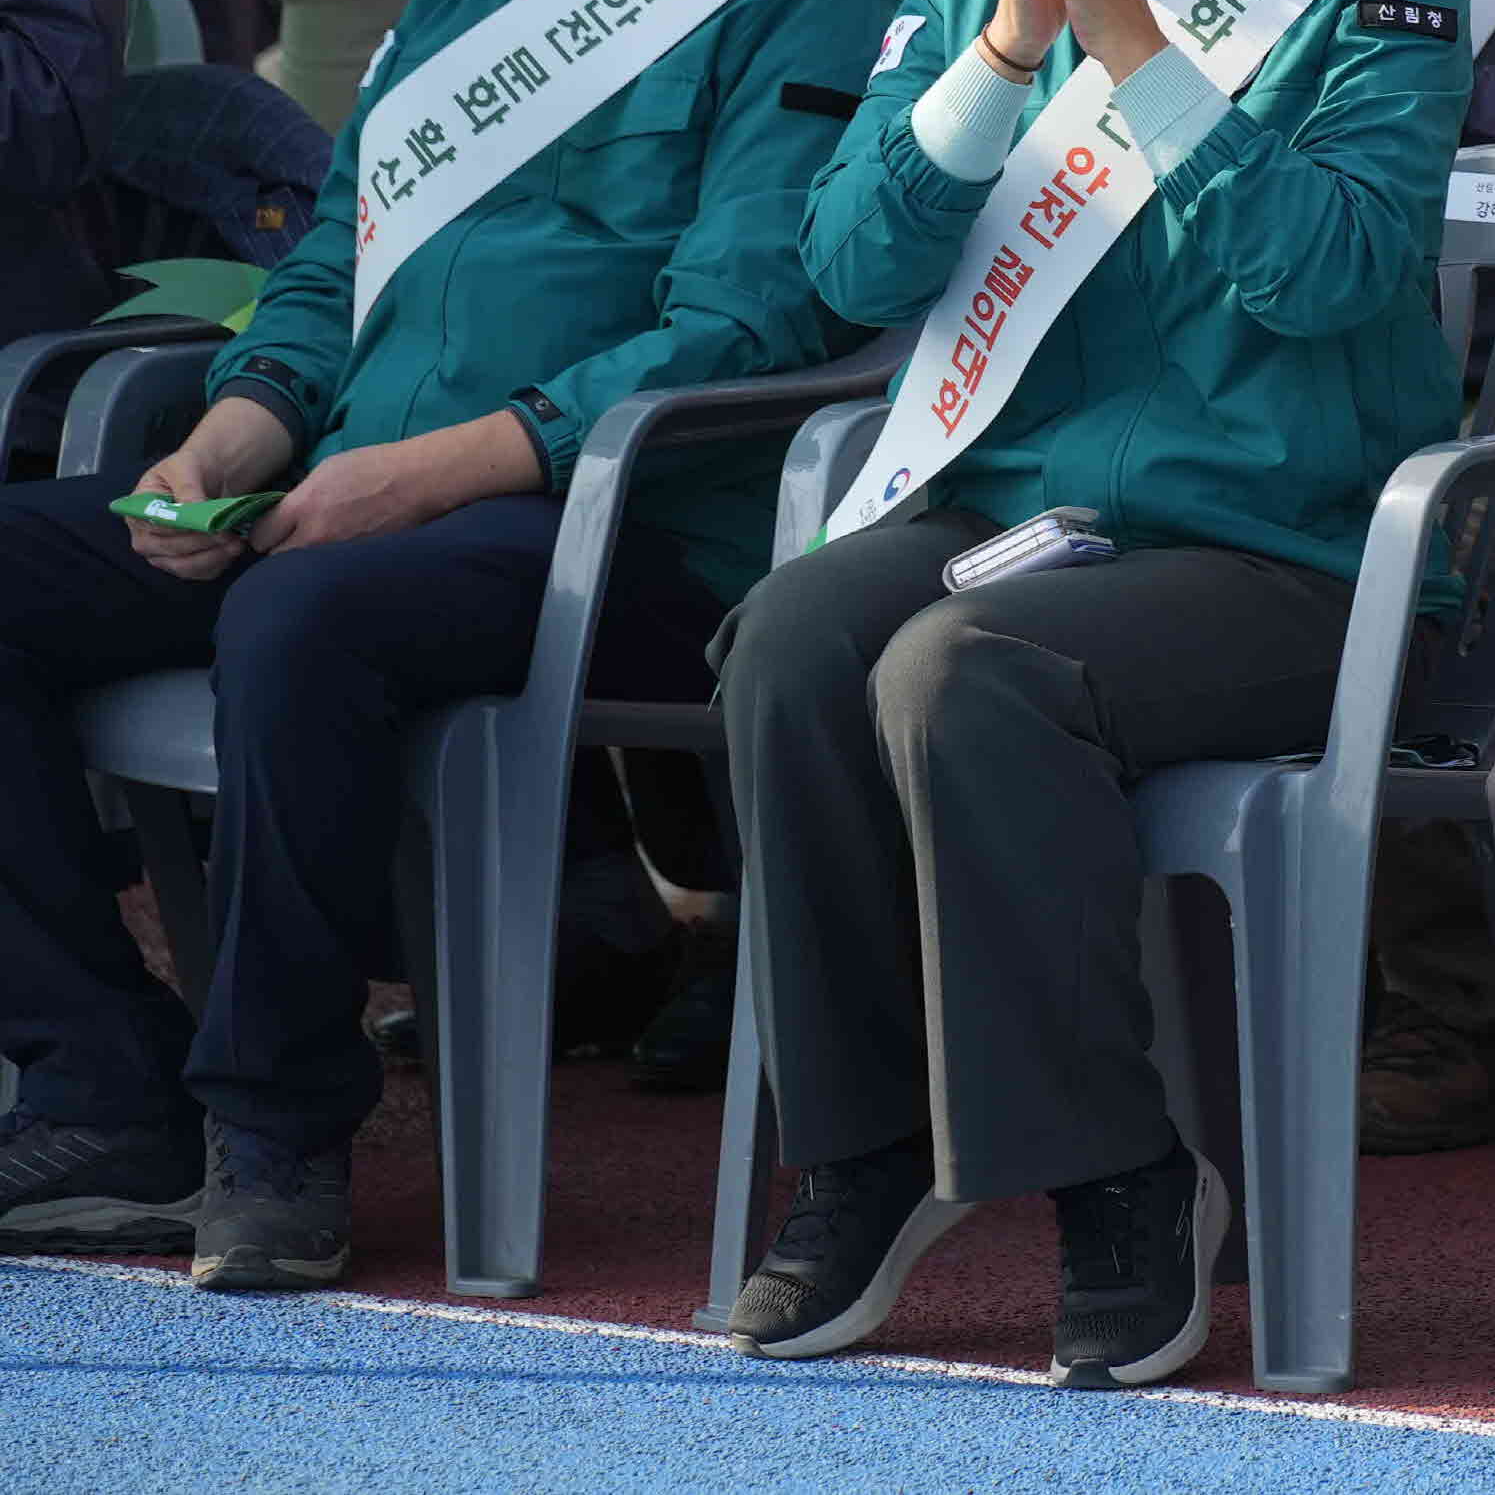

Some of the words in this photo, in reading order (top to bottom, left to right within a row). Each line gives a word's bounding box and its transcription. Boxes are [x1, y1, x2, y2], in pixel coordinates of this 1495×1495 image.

[1378, 4, 1443, 29] 산림청
[453, 47, 550, 135] 문화
[370, 119, 458, 209] 확산
[1020, 148, 1110, 247] 안전
[930, 246, 1033, 437] 결의대회
